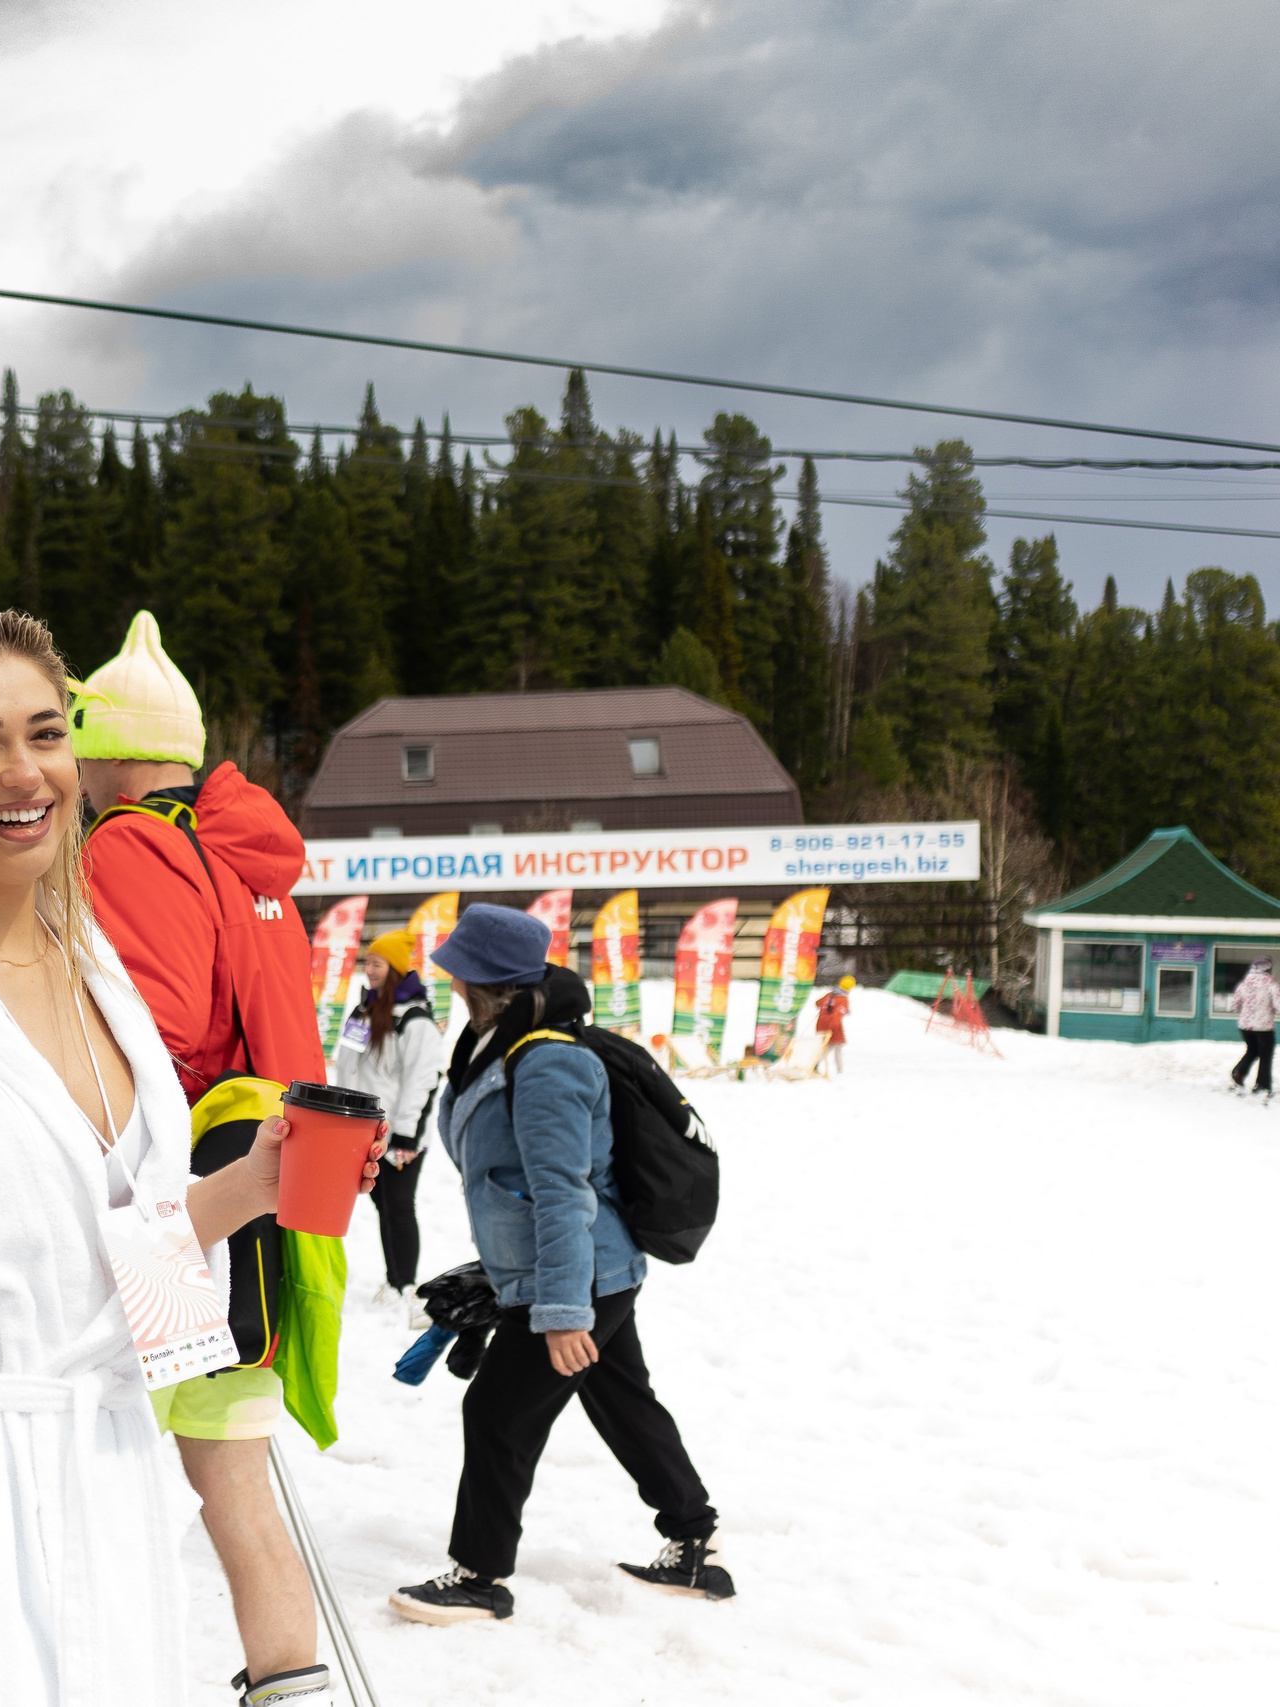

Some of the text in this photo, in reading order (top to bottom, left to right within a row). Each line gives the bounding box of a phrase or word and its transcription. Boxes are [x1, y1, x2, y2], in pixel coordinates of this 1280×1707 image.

[769, 833, 966, 852] 8-906-921-17-55
[346, 853, 503, 881] ИГРОВАЯ
[514, 847, 749, 876] ИНСТРУКТОР
[785, 855, 950, 881] sheregesh.biz
[149, 1347, 175, 1363] билайн
